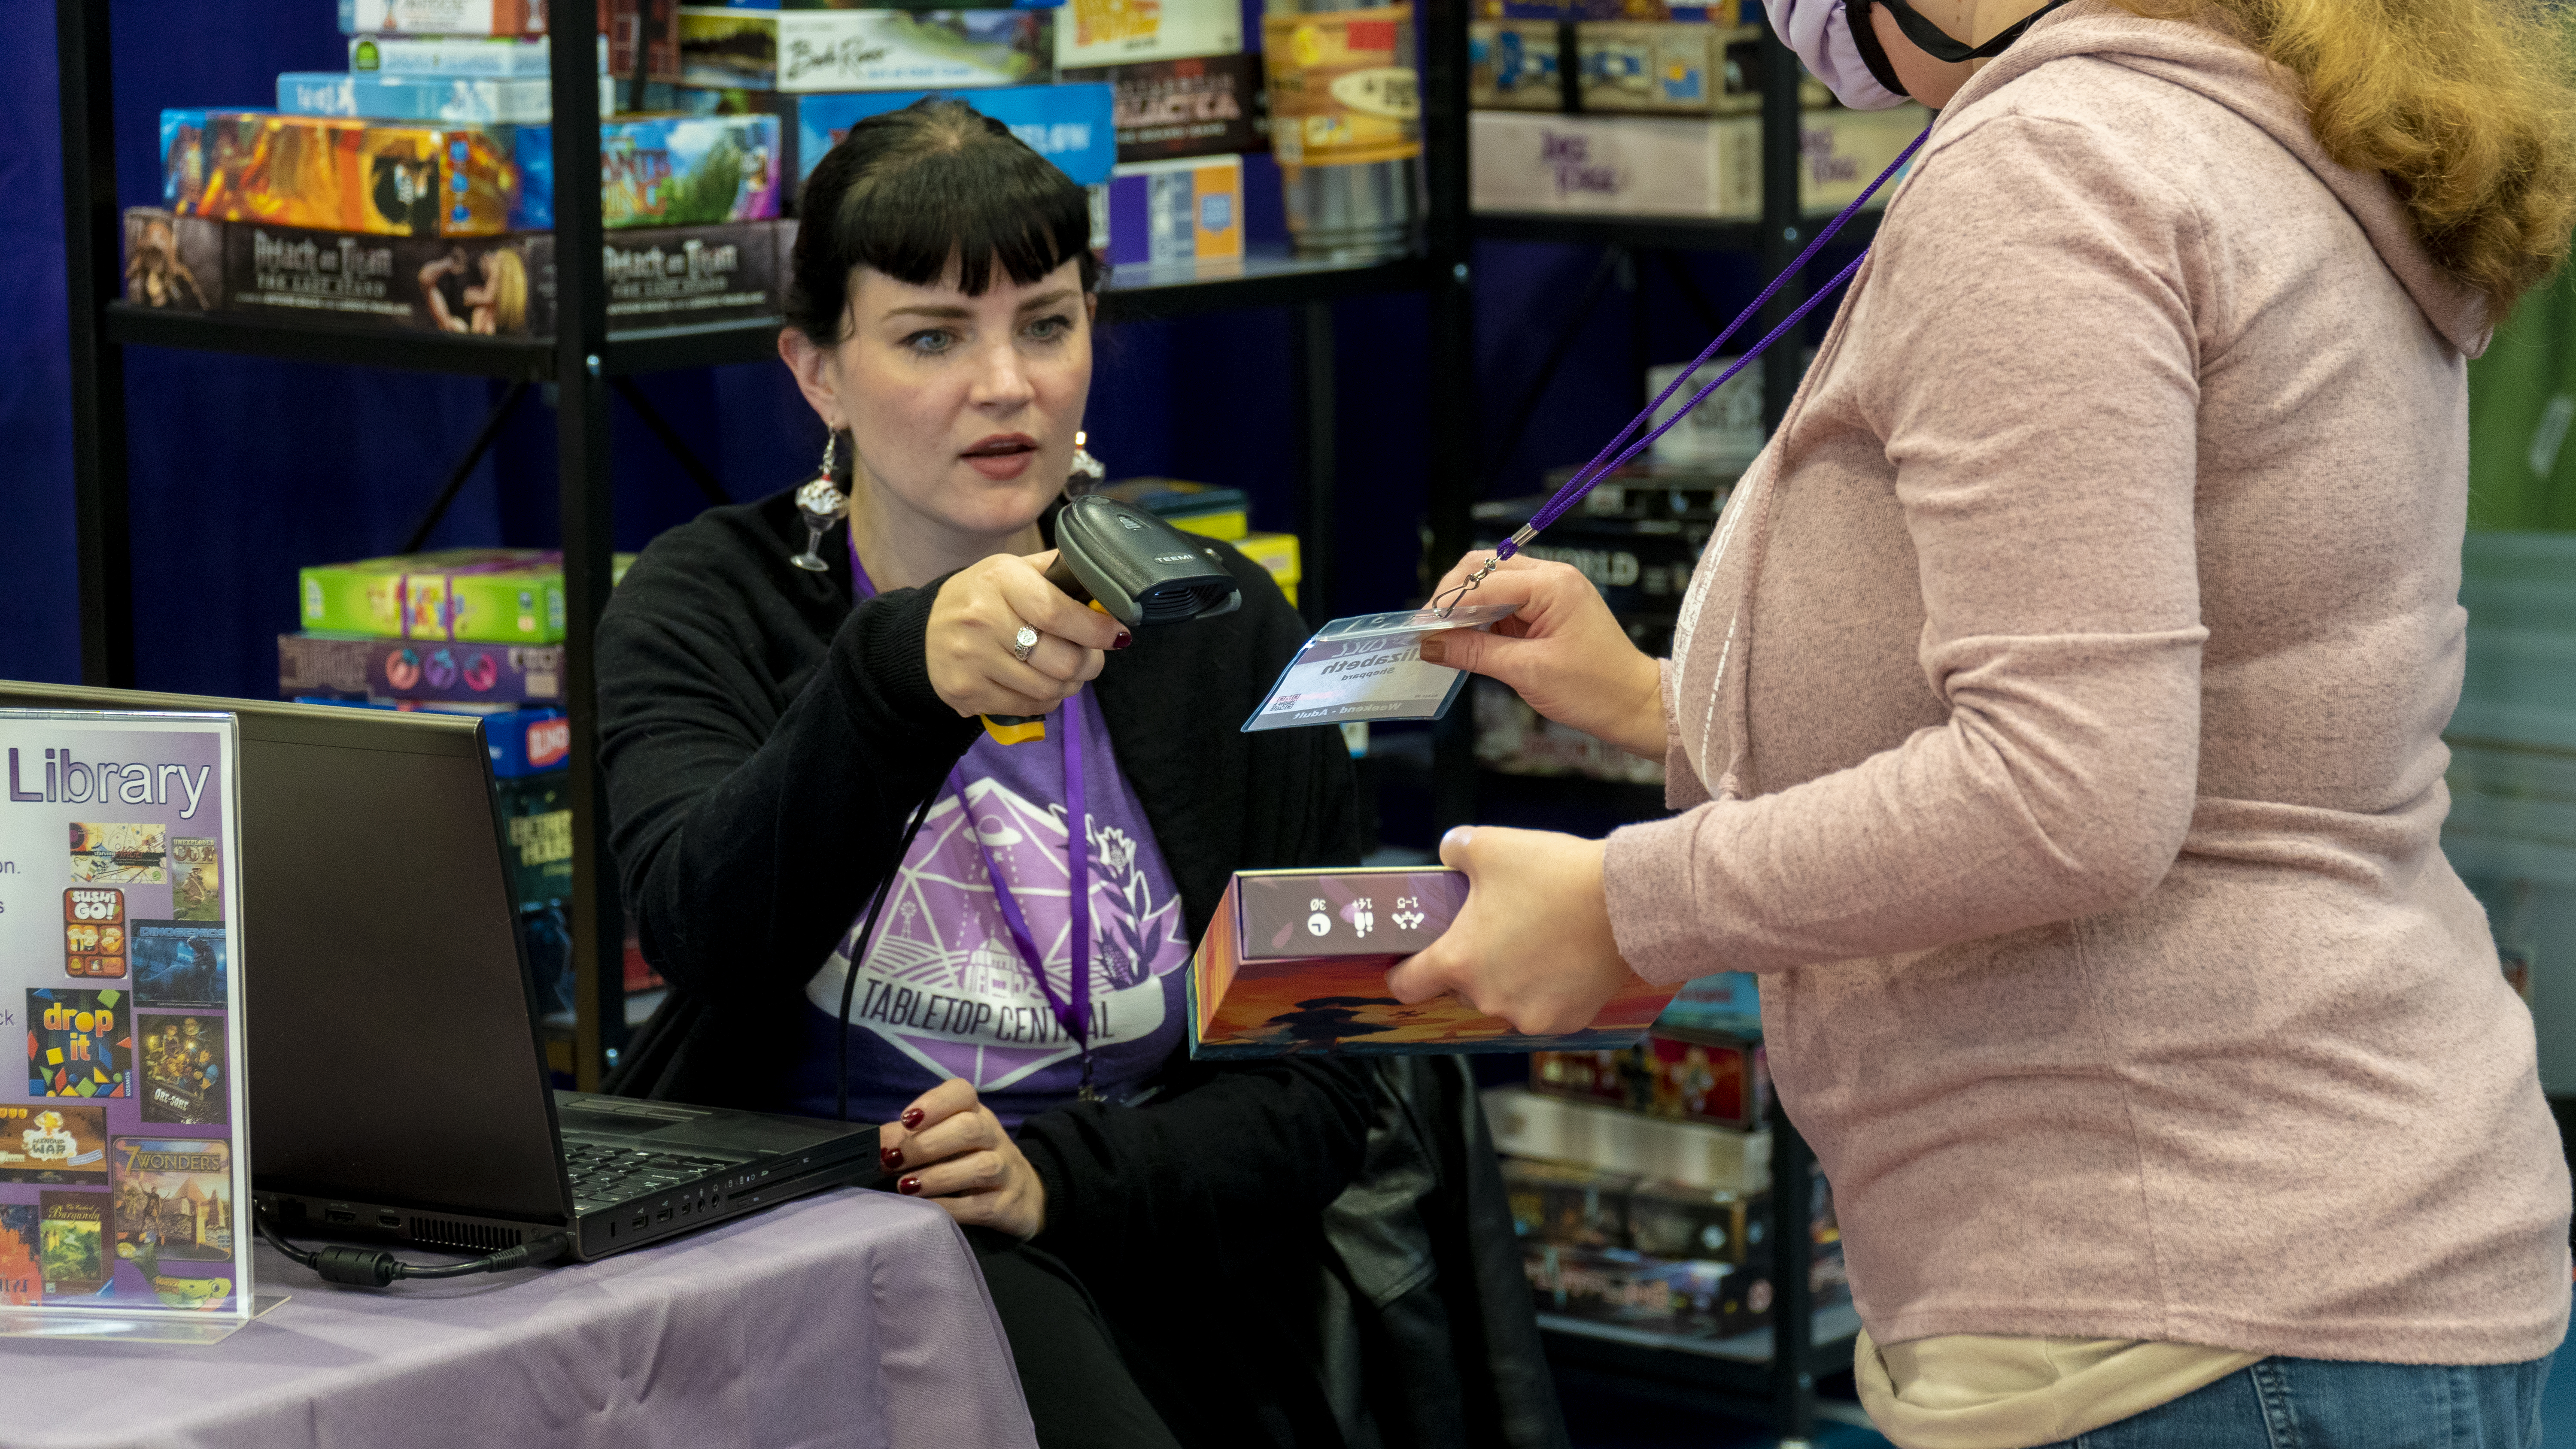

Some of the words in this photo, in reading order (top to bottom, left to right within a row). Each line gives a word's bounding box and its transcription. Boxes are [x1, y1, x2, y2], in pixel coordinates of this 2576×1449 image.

[1154, 554, 1194, 563] TEEMI
[8, 747, 210, 819] Library
[173, 846, 216, 862] COW
[74, 902, 114, 920] GO!
[1352, 897, 1373, 910] 14+
[1397, 897, 1419, 909] 1-5
[140, 927, 226, 938] DINOGENICS
[860, 978, 991, 1035] TABLETOP
[996, 1001, 1114, 1043] CENTAL
[43, 1002, 113, 1038] drop
[70, 1032, 90, 1061] it
[32, 1144, 66, 1154] WAR
[122, 1146, 141, 1176] 7
[137, 1154, 220, 1171] WONDERS
[48, 1204, 100, 1226] Burgundy
